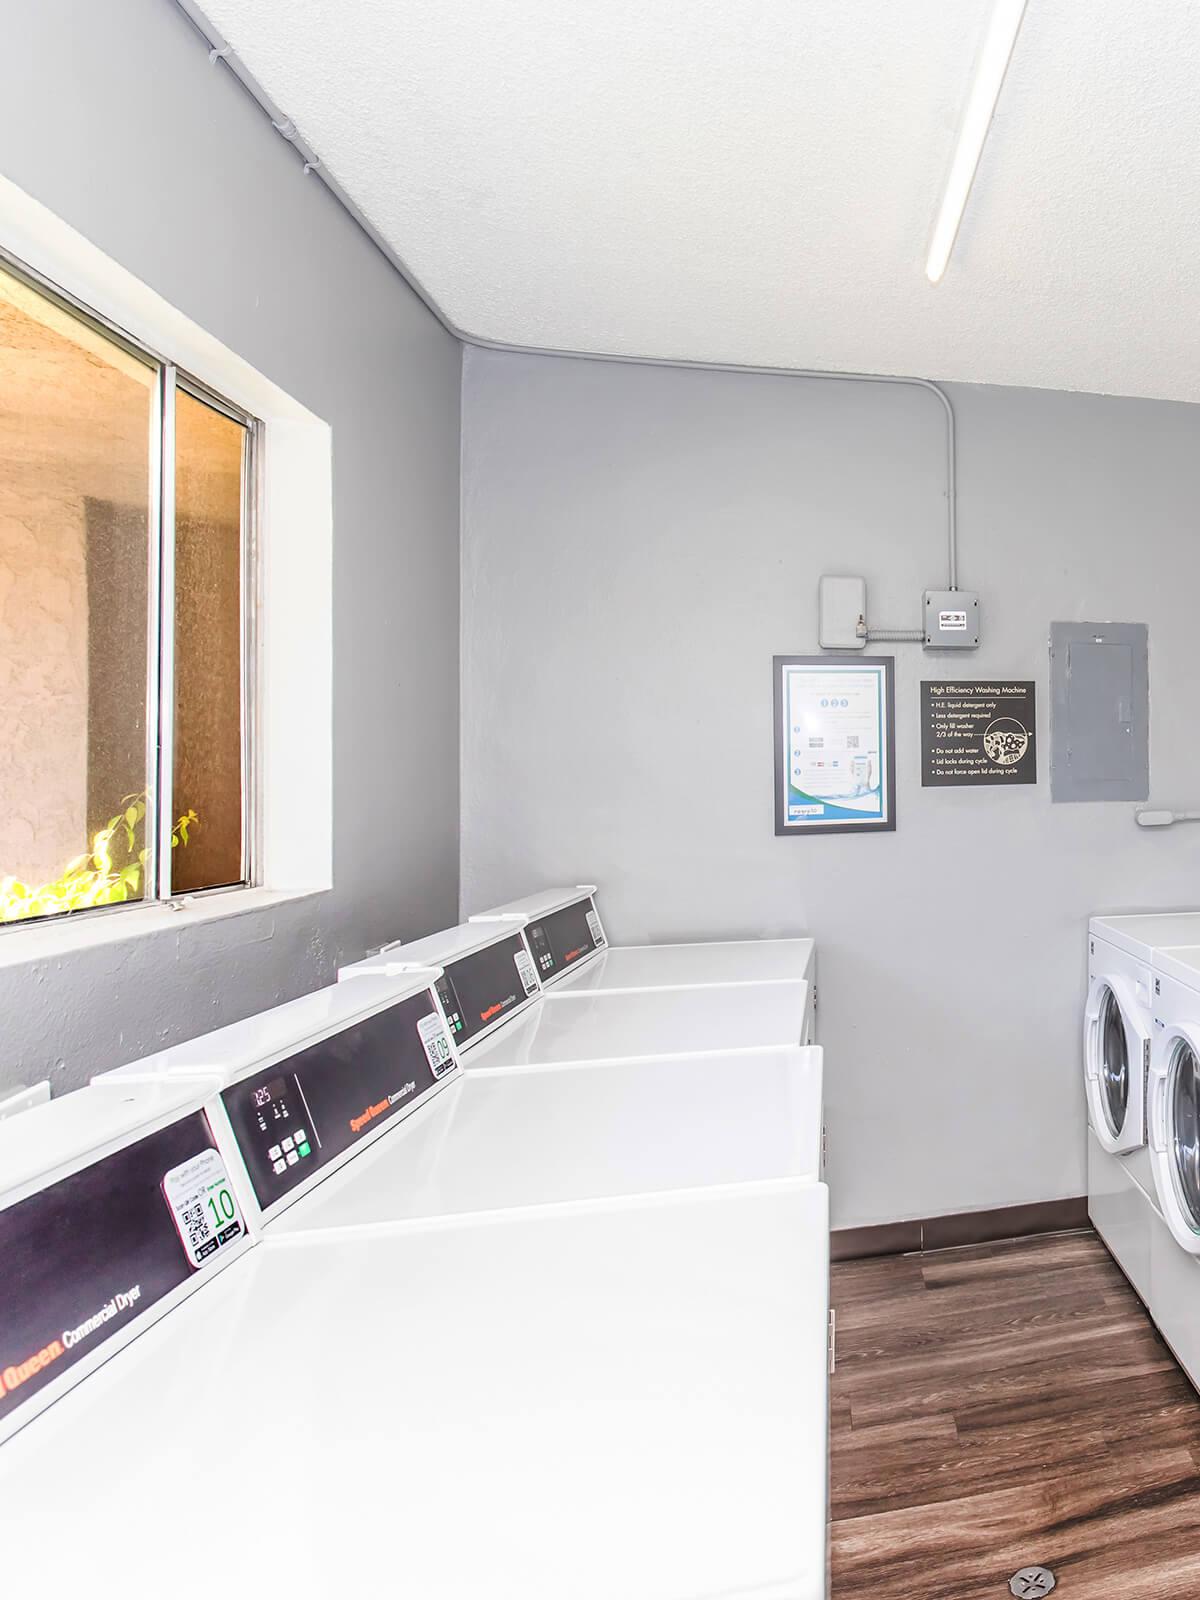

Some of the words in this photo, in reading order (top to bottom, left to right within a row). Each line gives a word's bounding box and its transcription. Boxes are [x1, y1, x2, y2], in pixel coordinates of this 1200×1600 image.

[930, 686, 945, 695] High
[946, 687, 974, 695] Efficiency
[974, 687, 1001, 695] Washing
[1001, 686, 1027, 694] Machine
[962, 702, 985, 710] detergent
[947, 712, 970, 720] detergent
[971, 712, 991, 720] required
[437, 1037, 450, 1059] 09
[207, 1189, 235, 1228] 10
[3, 1340, 62, 1390] Queen
[62, 1299, 118, 1349] Commercial
[115, 1285, 141, 1311] Dryer
